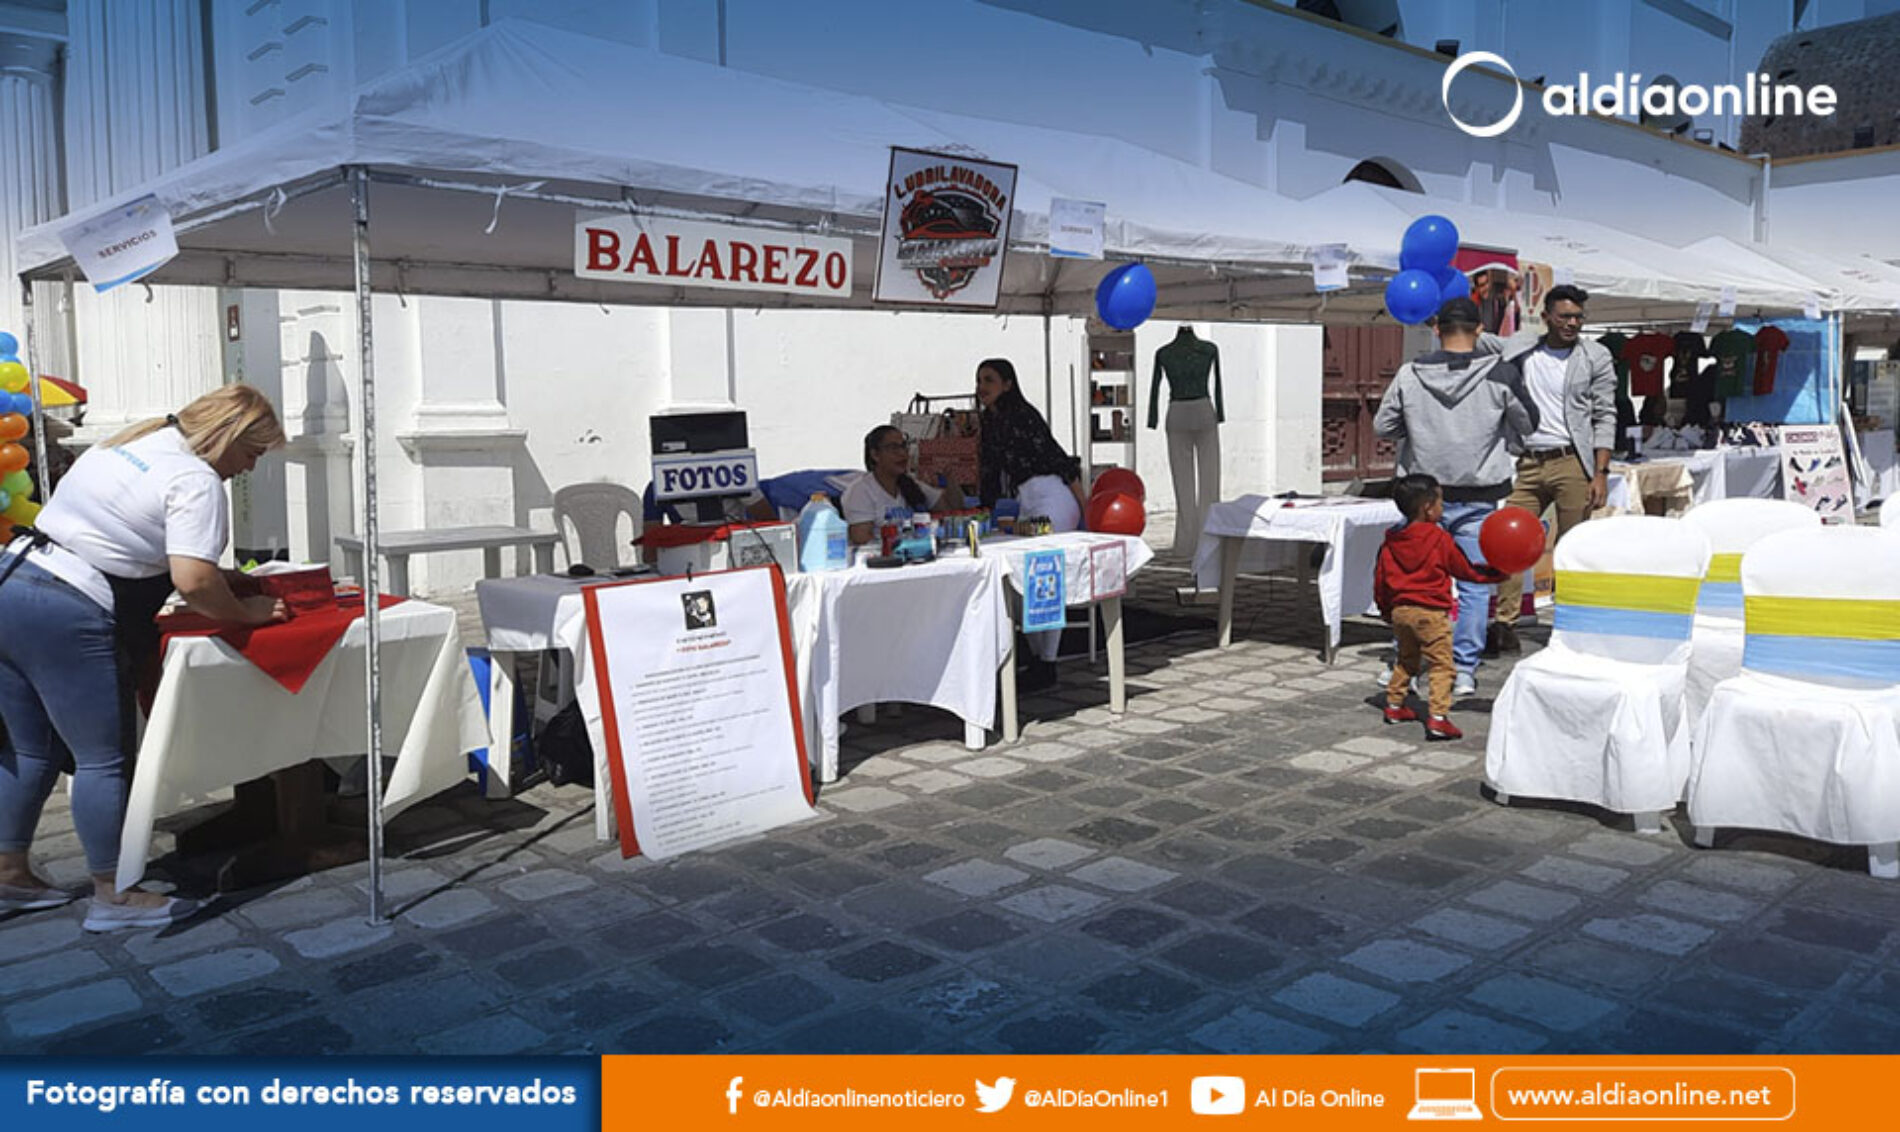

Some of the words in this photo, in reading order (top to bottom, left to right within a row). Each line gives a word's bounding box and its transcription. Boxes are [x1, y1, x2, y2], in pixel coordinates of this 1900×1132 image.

[894, 165, 1007, 211] LUBRILAVADORA
[98, 229, 157, 258] SERVICIOS
[586, 228, 847, 290] BALAREZO
[662, 464, 748, 492] FOTOS
